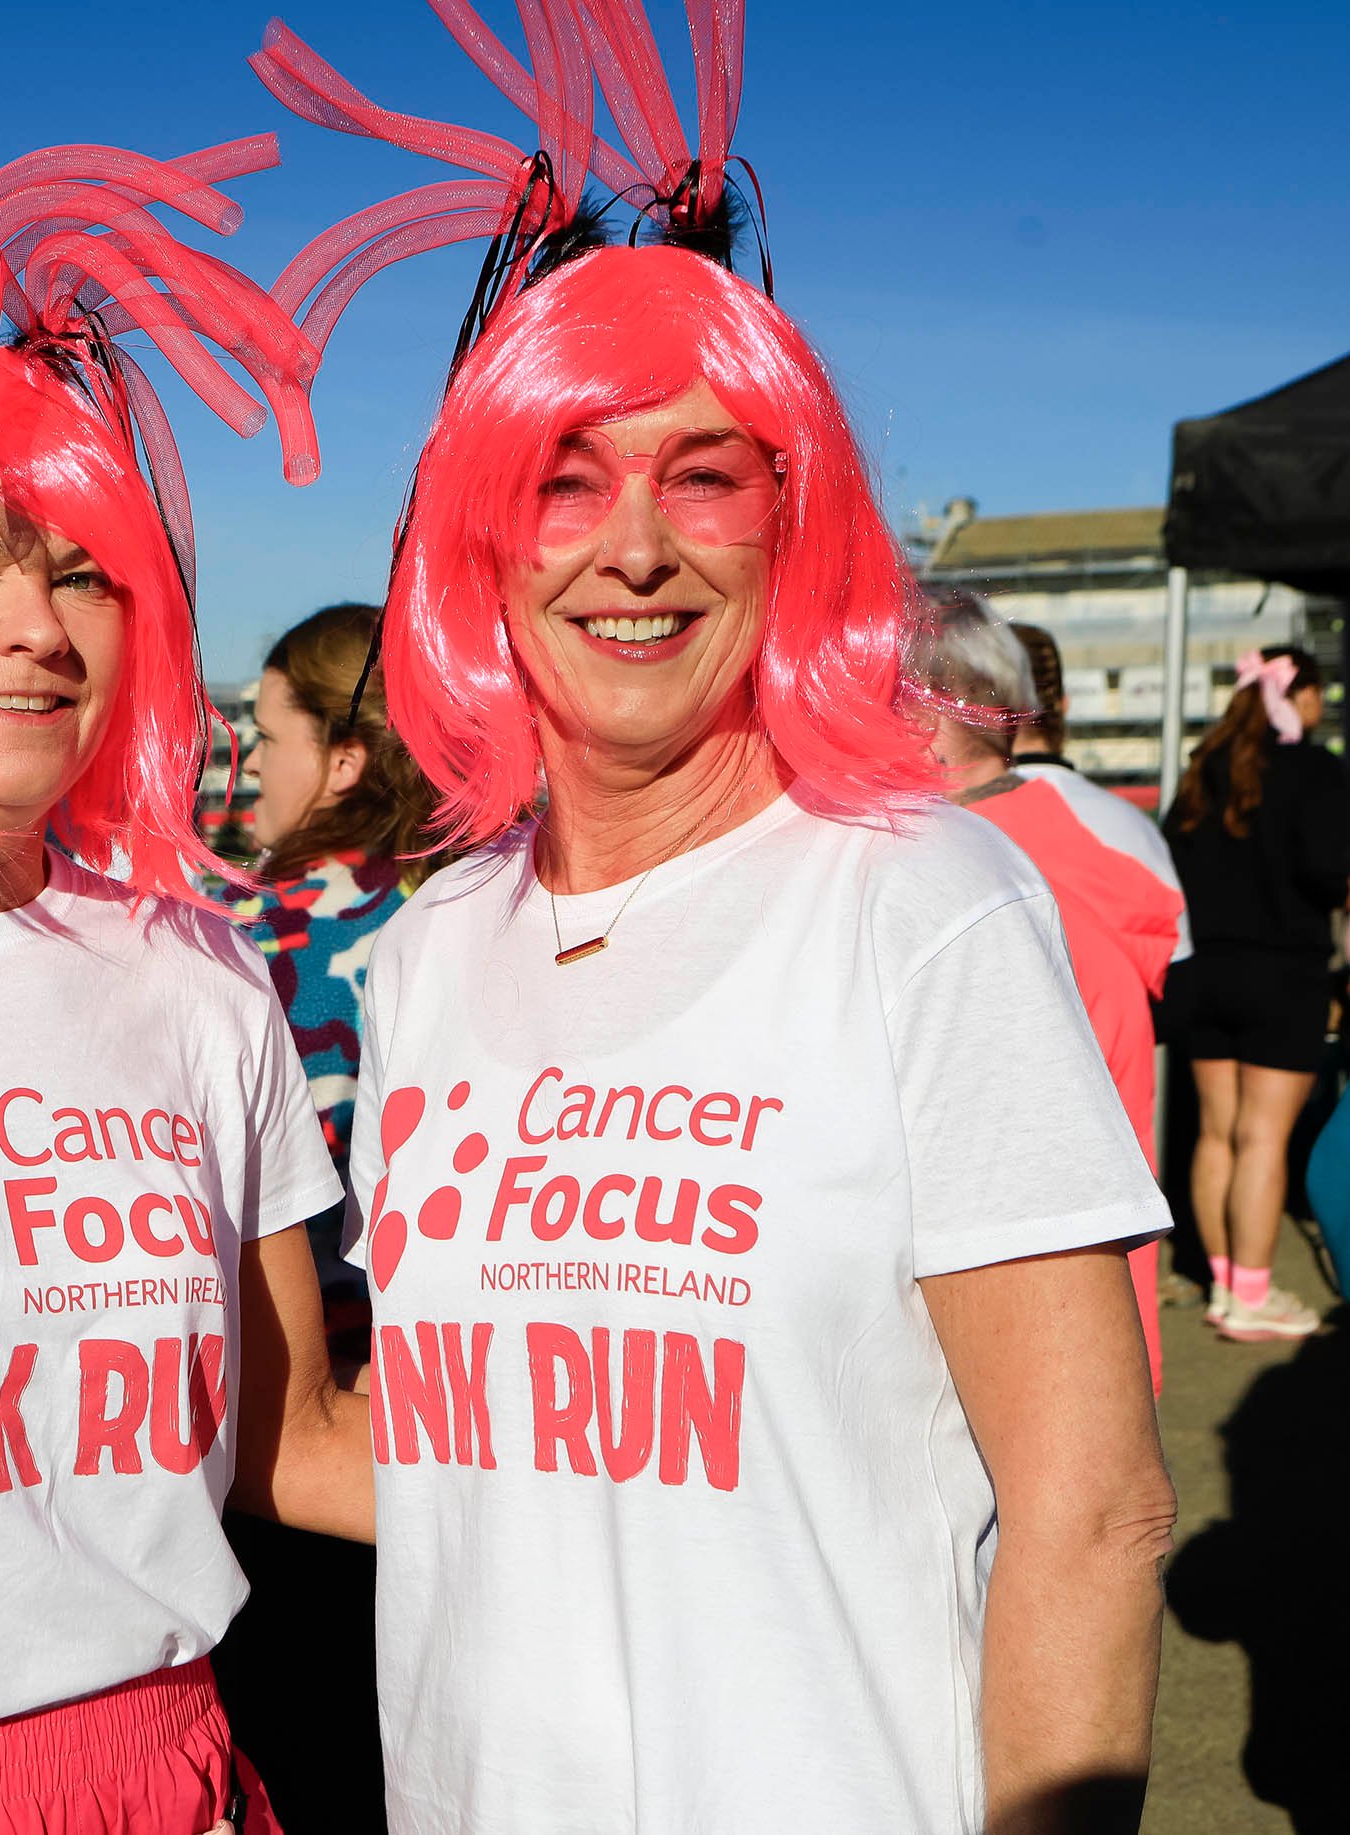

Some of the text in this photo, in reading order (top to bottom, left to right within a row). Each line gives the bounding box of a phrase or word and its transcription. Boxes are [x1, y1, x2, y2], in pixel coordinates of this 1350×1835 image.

[517, 1066, 784, 1151] Cancer
[485, 1155, 763, 1254] Focus
[23, 1277, 178, 1314] NORTHERN
[480, 1262, 751, 1307] NORTHERN IRELAND
[526, 1322, 746, 1492] RUN
